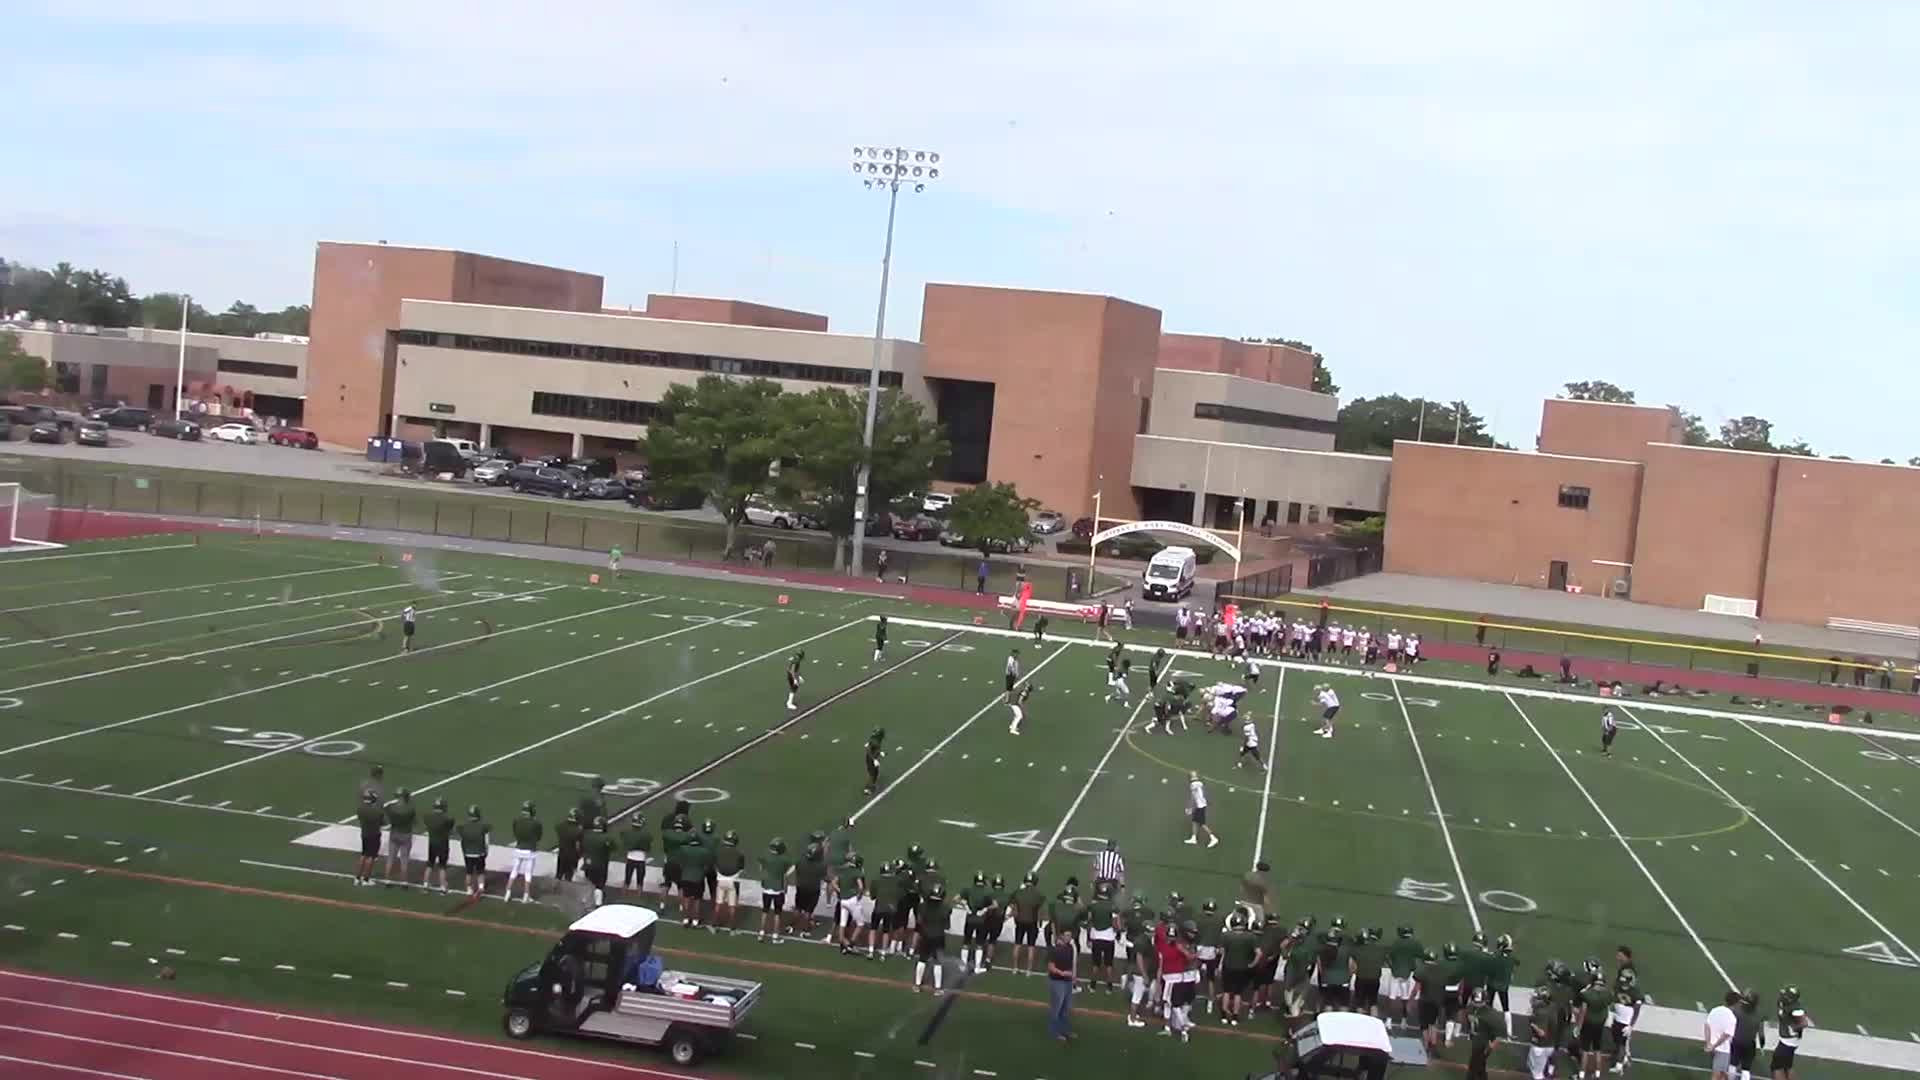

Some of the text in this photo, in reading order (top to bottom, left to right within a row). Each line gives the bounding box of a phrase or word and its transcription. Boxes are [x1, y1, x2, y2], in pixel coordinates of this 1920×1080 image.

[223, 731, 364, 756] 20
[601, 778, 730, 803] 30
[1395, 877, 1537, 912] 50
